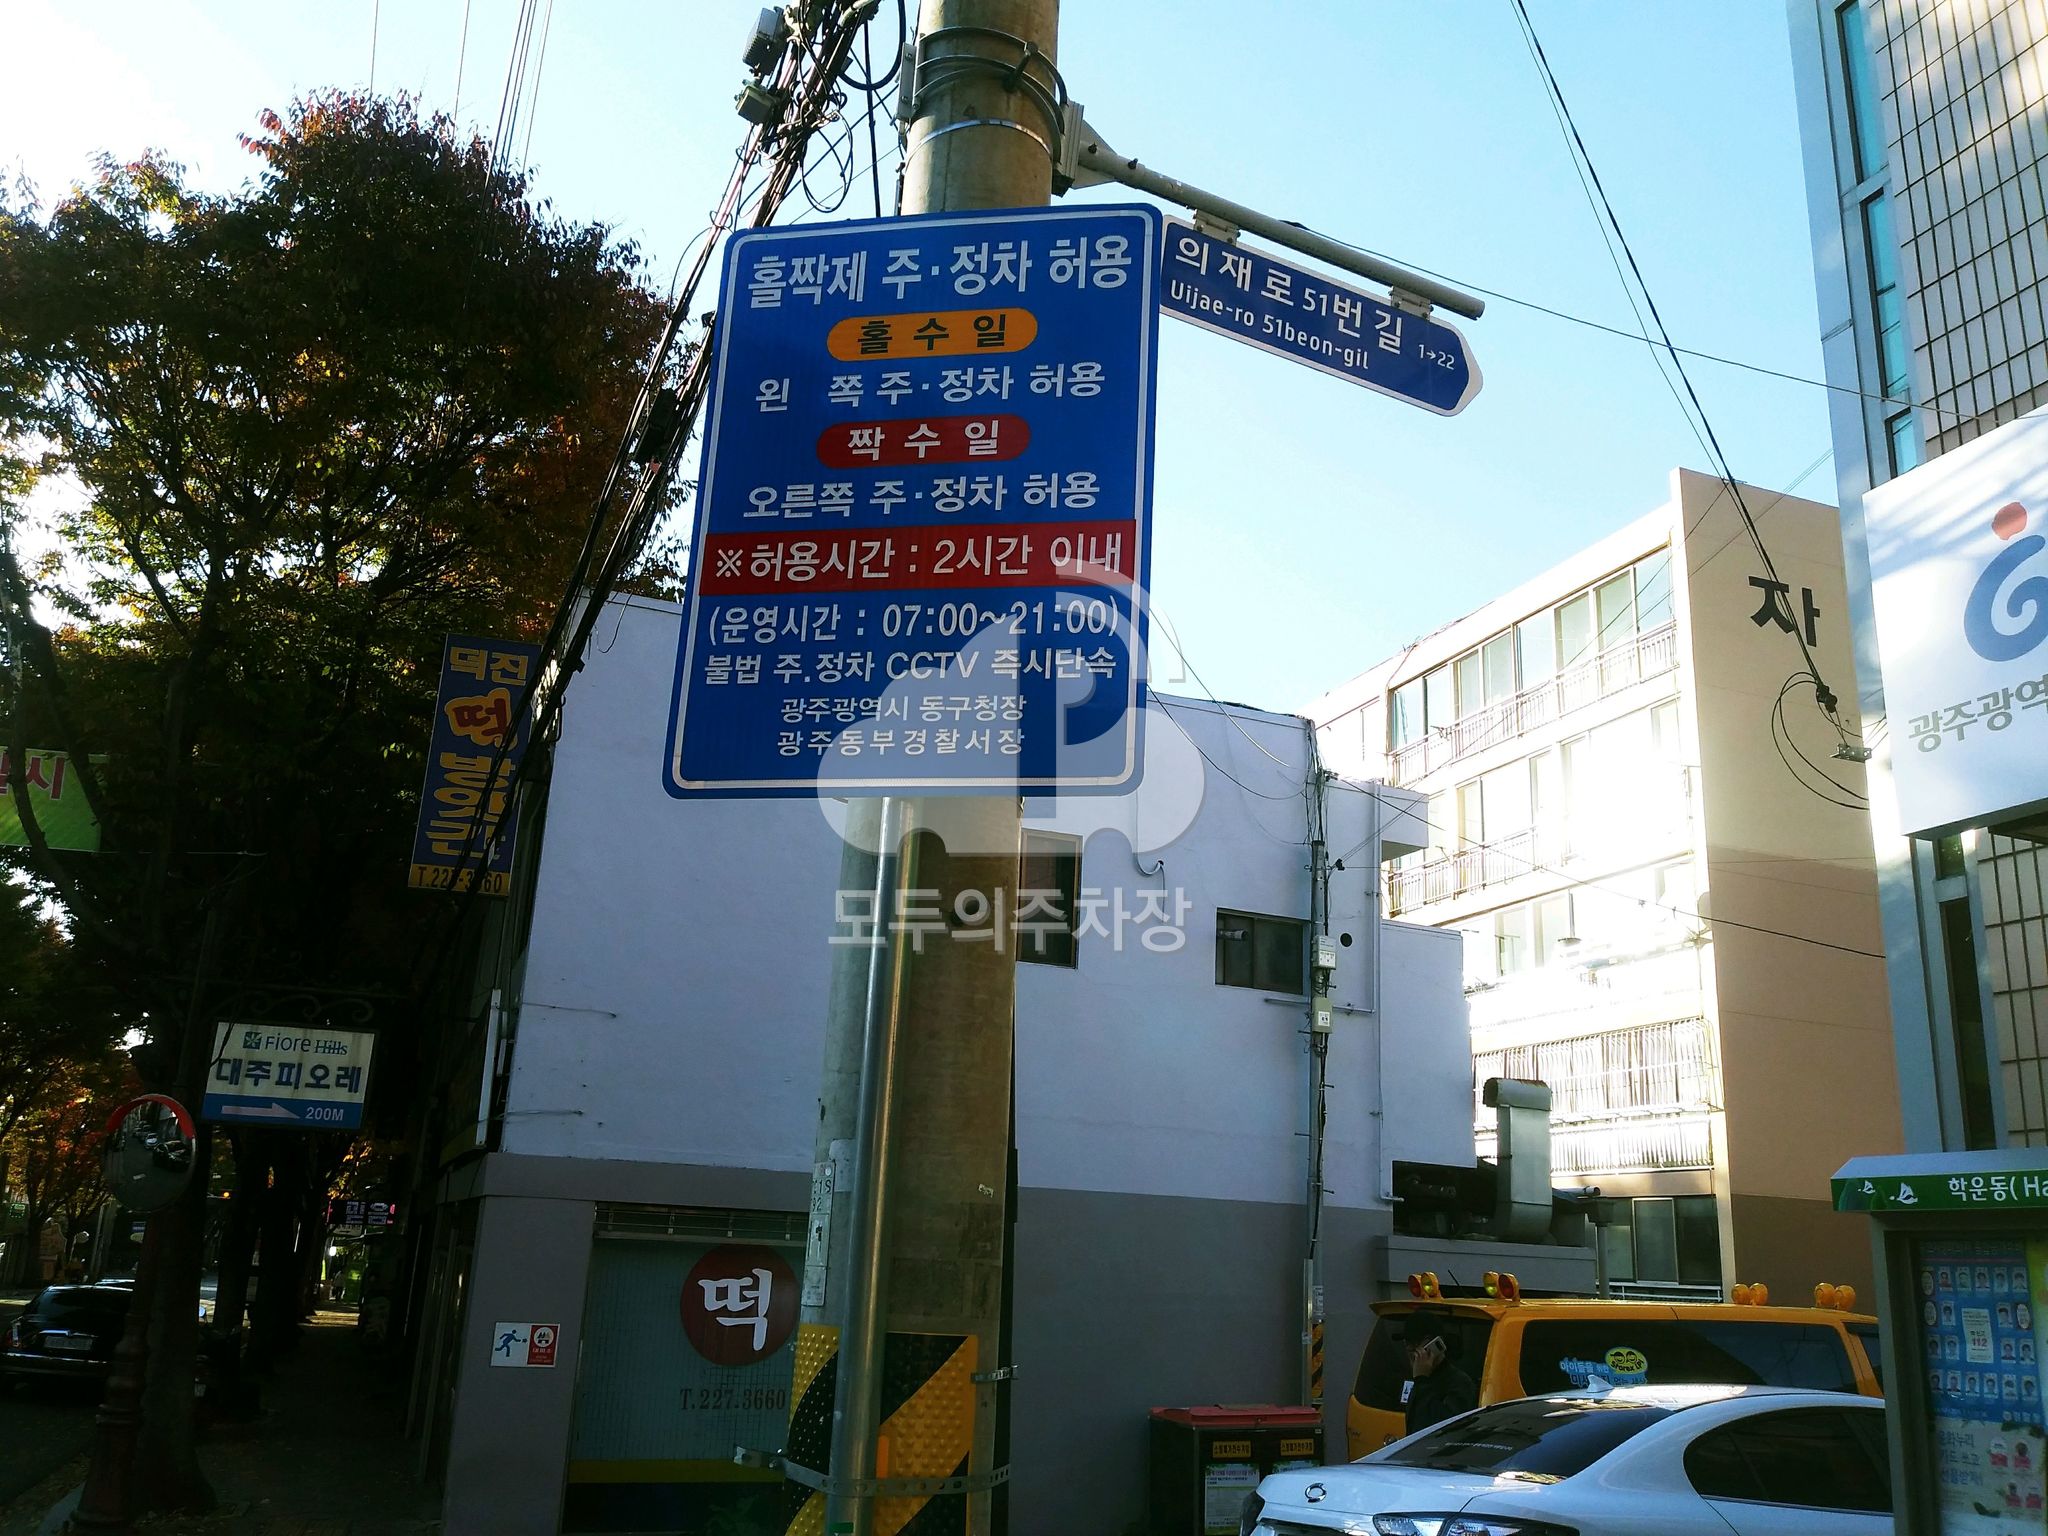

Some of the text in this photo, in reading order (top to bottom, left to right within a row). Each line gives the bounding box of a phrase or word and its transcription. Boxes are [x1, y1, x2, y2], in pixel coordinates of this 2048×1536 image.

[748, 251, 867, 308] 홀짝제
[1049, 235, 1131, 288] 허용
[1170, 279, 1369, 370] Uijae-ro 51beon-gil
[1029, 361, 1105, 398] 허용
[743, 483, 855, 518] 오른쪽
[1022, 471, 1100, 509] 허용
[933, 534, 1033, 576] 2시간
[1049, 532, 1122, 575] 이내
[708, 603, 841, 647] (운영시간
[882, 595, 1120, 639] 07:00~21:00)
[1748, 576, 1820, 647] 자
[450, 646, 528, 686] 덕진
[704, 646, 1117, 685] 불법 주.정차 CCTV 즉시단속
[780, 695, 1027, 723] 광주광역시 동구청장
[265, 1033, 348, 1056] Fiore Hills
[216, 1058, 362, 1093] 대주피오레
[305, 1106, 344, 1121] 200M
[698, 1268, 773, 1352] 떡
